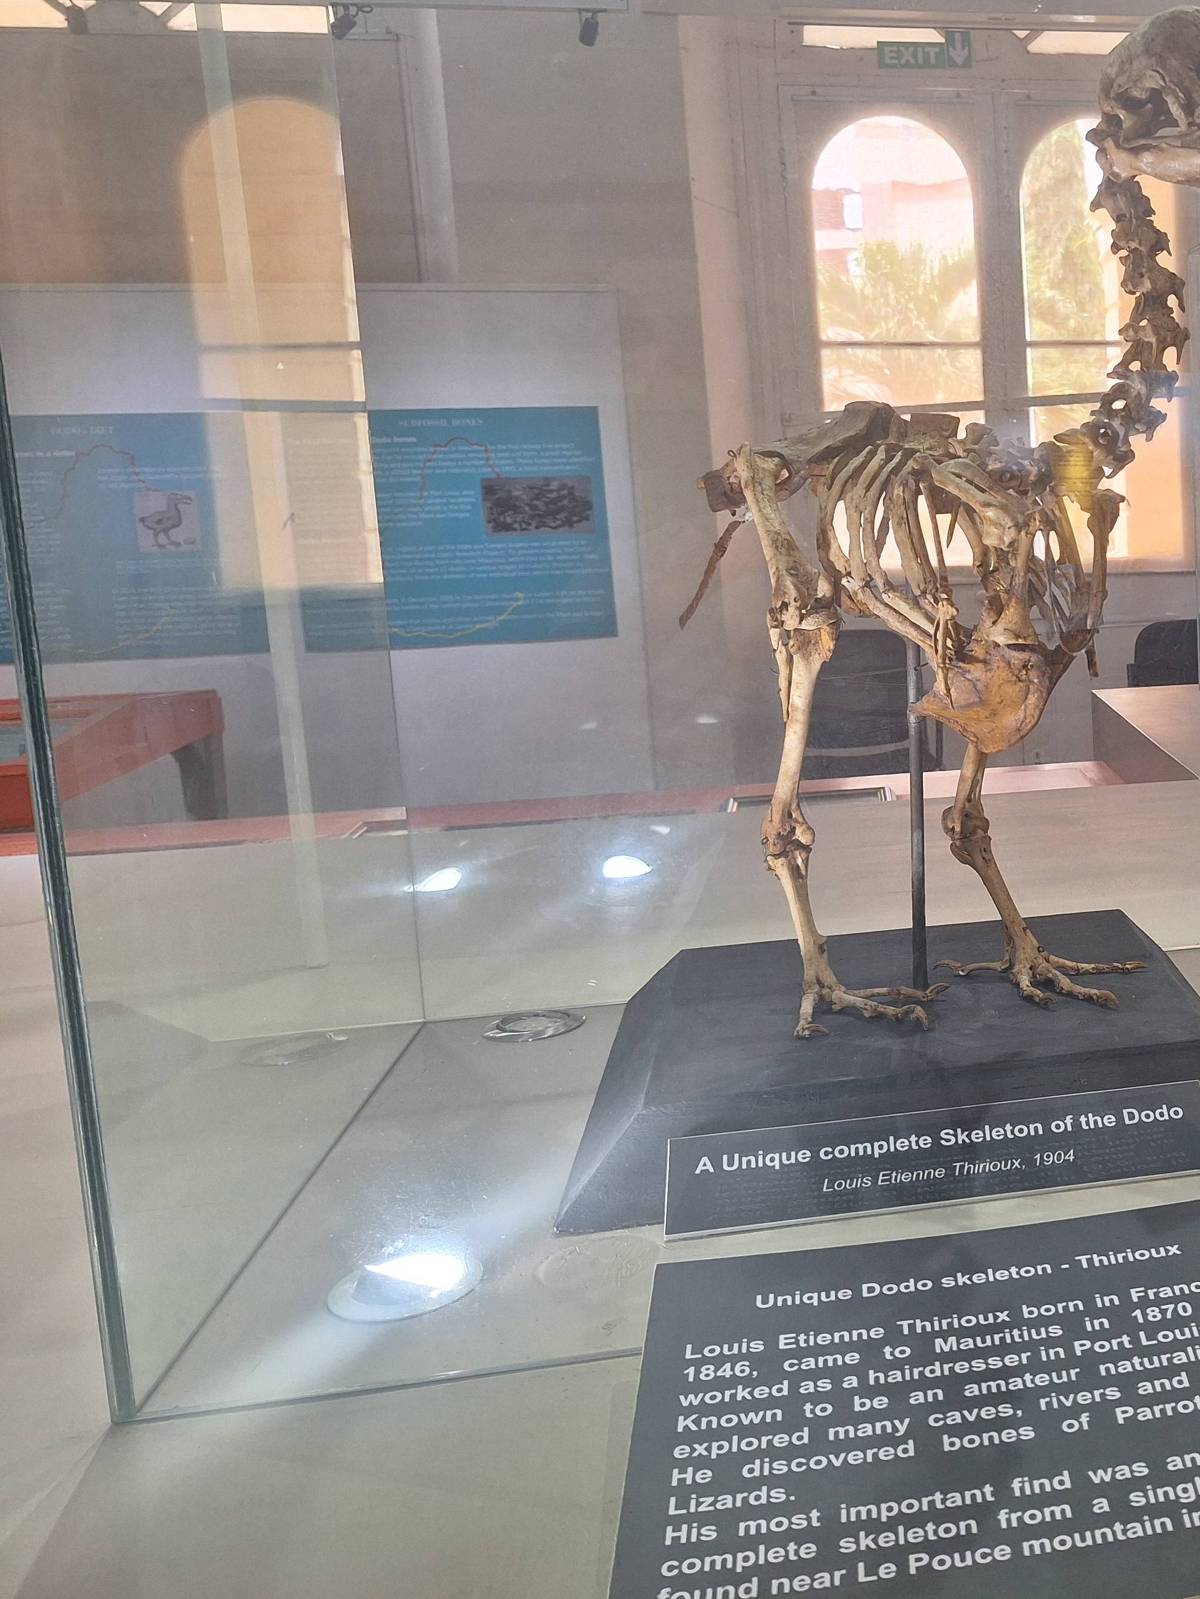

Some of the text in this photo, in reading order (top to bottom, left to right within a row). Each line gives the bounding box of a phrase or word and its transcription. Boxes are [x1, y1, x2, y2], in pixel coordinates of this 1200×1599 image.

[884, 46, 940, 65] EXIT
[695, 1105, 1183, 1174] A Unique complete Skeleton of the Dodo
[823, 1149, 1074, 1191] Louis Etienne Thirioux, 1904
[756, 1245, 1182, 1308] Unique Dodo skeleton Thirioux
[684, 1361, 757, 1382] 1846,
[784, 1353, 860, 1371] came
[883, 1346, 911, 1359] to
[935, 1325, 1063, 1353] Mauritius
[1085, 1317, 1109, 1331] in
[1131, 1302, 1192, 1323] 1870
[685, 1339, 764, 1359] Louis
[779, 1327, 884, 1349] Etienne
[896, 1311, 1010, 1334] Thirioux
[1022, 1300, 1084, 1318] born
[1094, 1294, 1119, 1307] in
[677, 1409, 782, 1432] Known
[803, 1402, 833, 1417] to
[854, 1396, 888, 1411] be
[909, 1389, 943, 1404] an
[964, 1368, 1080, 1396] amateur
[679, 1380, 788, 1406] worked
[799, 1379, 832, 1393] as
[842, 1376, 858, 1388] a
[869, 1352, 1031, 1385] hairdresser
[1040, 1346, 1065, 1361] in
[1073, 1334, 1133, 1356] Port
[671, 1467, 712, 1486] He
[742, 1439, 914, 1478] discovered
[943, 1426, 1035, 1451] bones
[1062, 1412, 1090, 1432] of
[673, 1427, 809, 1459] explored
[829, 1418, 910, 1440] many
[928, 1404, 1022, 1426] caves,
[1040, 1387, 1121, 1410] rivers
[1137, 1372, 1190, 1394] and
[665, 1523, 717, 1545] His
[739, 1509, 820, 1536] most
[840, 1484, 995, 1522] important
[1011, 1470, 1071, 1496] find
[1088, 1462, 1149, 1483] was
[668, 1486, 795, 1515] Lizards.
[661, 1542, 817, 1576] complete
[839, 1520, 977, 1553] skeleton
[997, 1504, 1072, 1528] from
[1092, 1498, 1110, 1513] a
